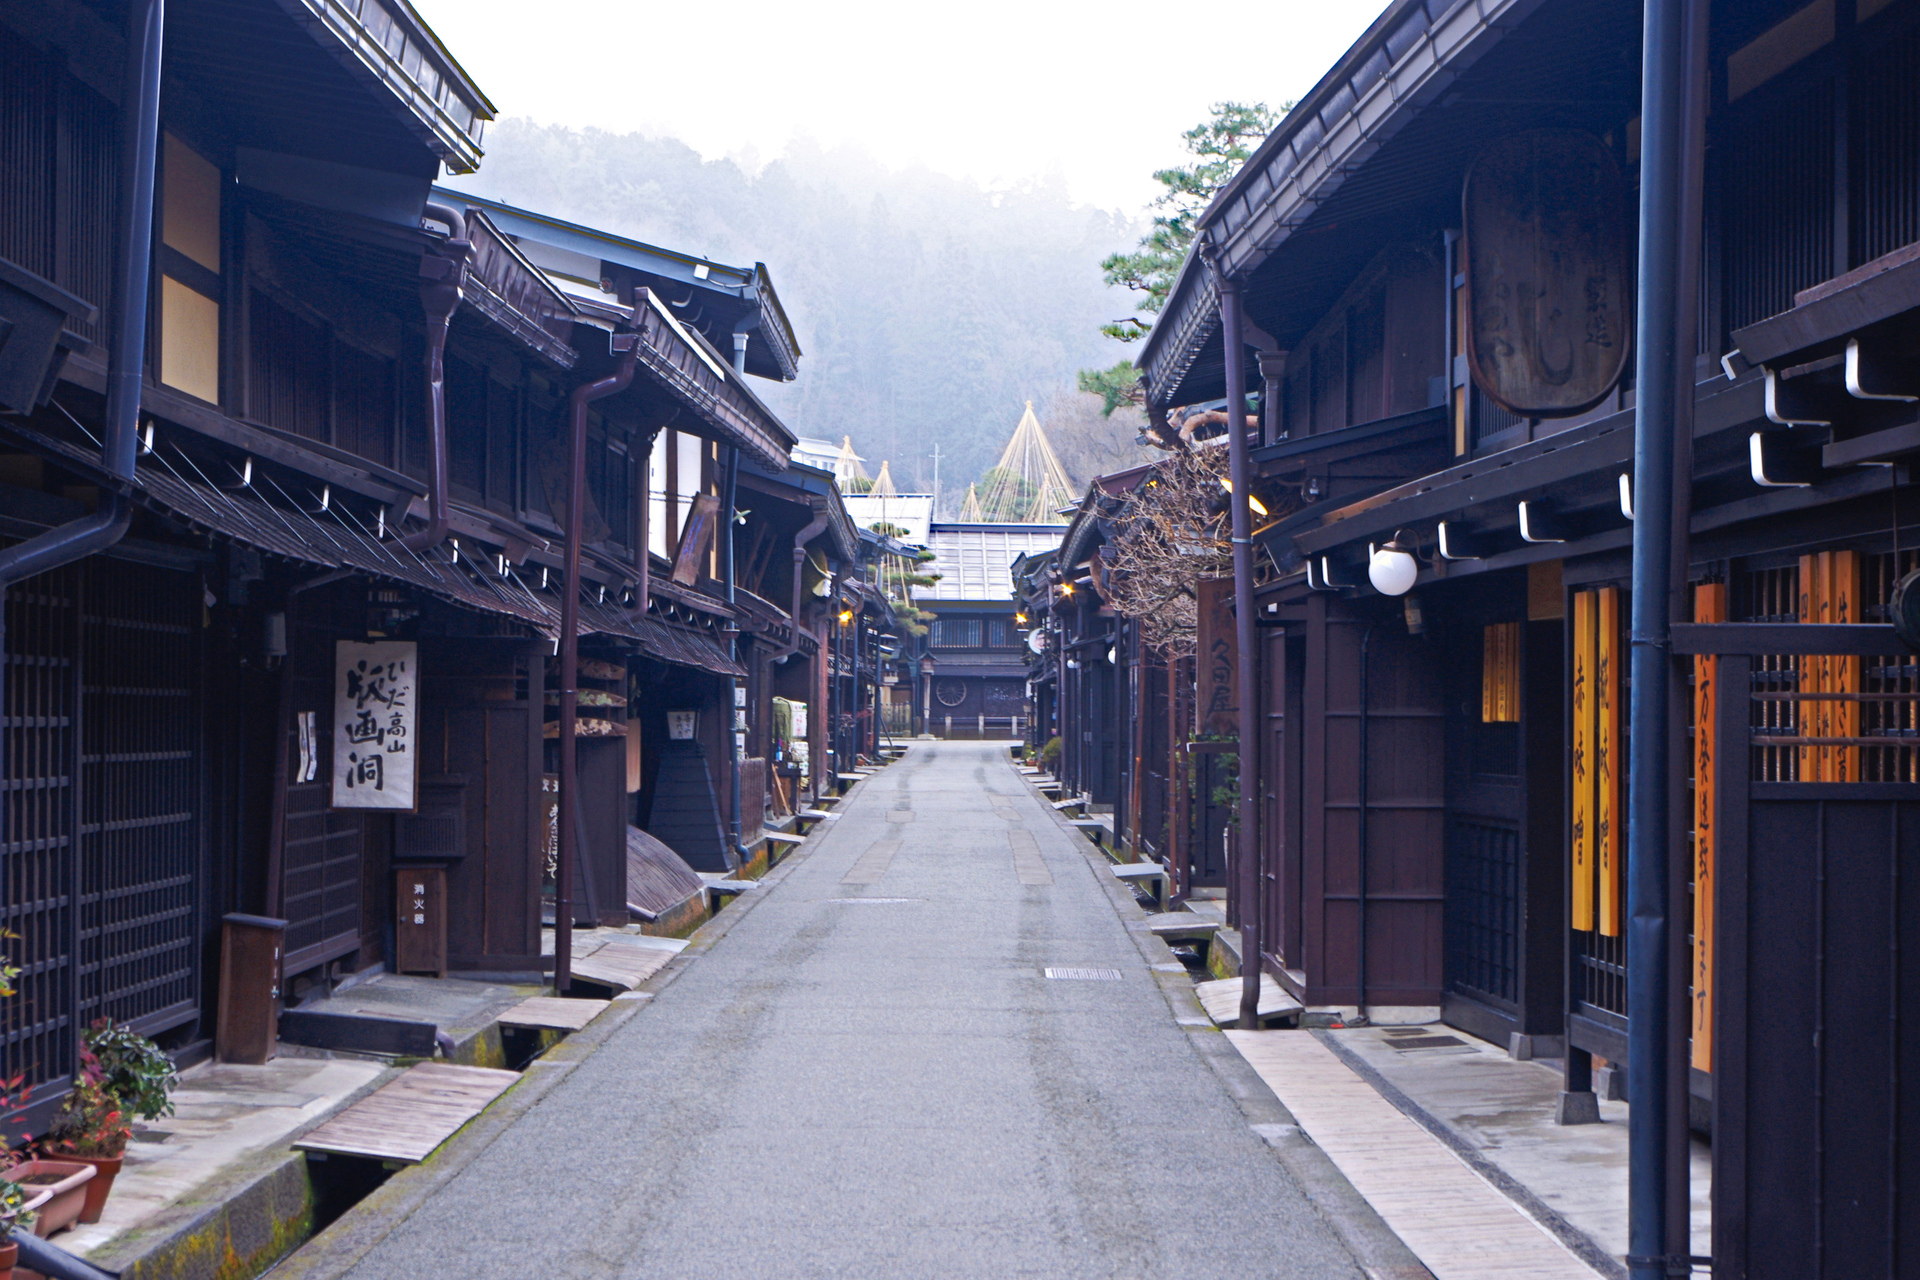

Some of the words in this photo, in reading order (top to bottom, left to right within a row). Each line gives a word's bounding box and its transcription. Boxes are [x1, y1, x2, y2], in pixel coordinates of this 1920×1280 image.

[345, 660, 388, 791] 版画洞
[386, 660, 410, 754] ひだ高山
[413, 883, 425, 925] 消火器
